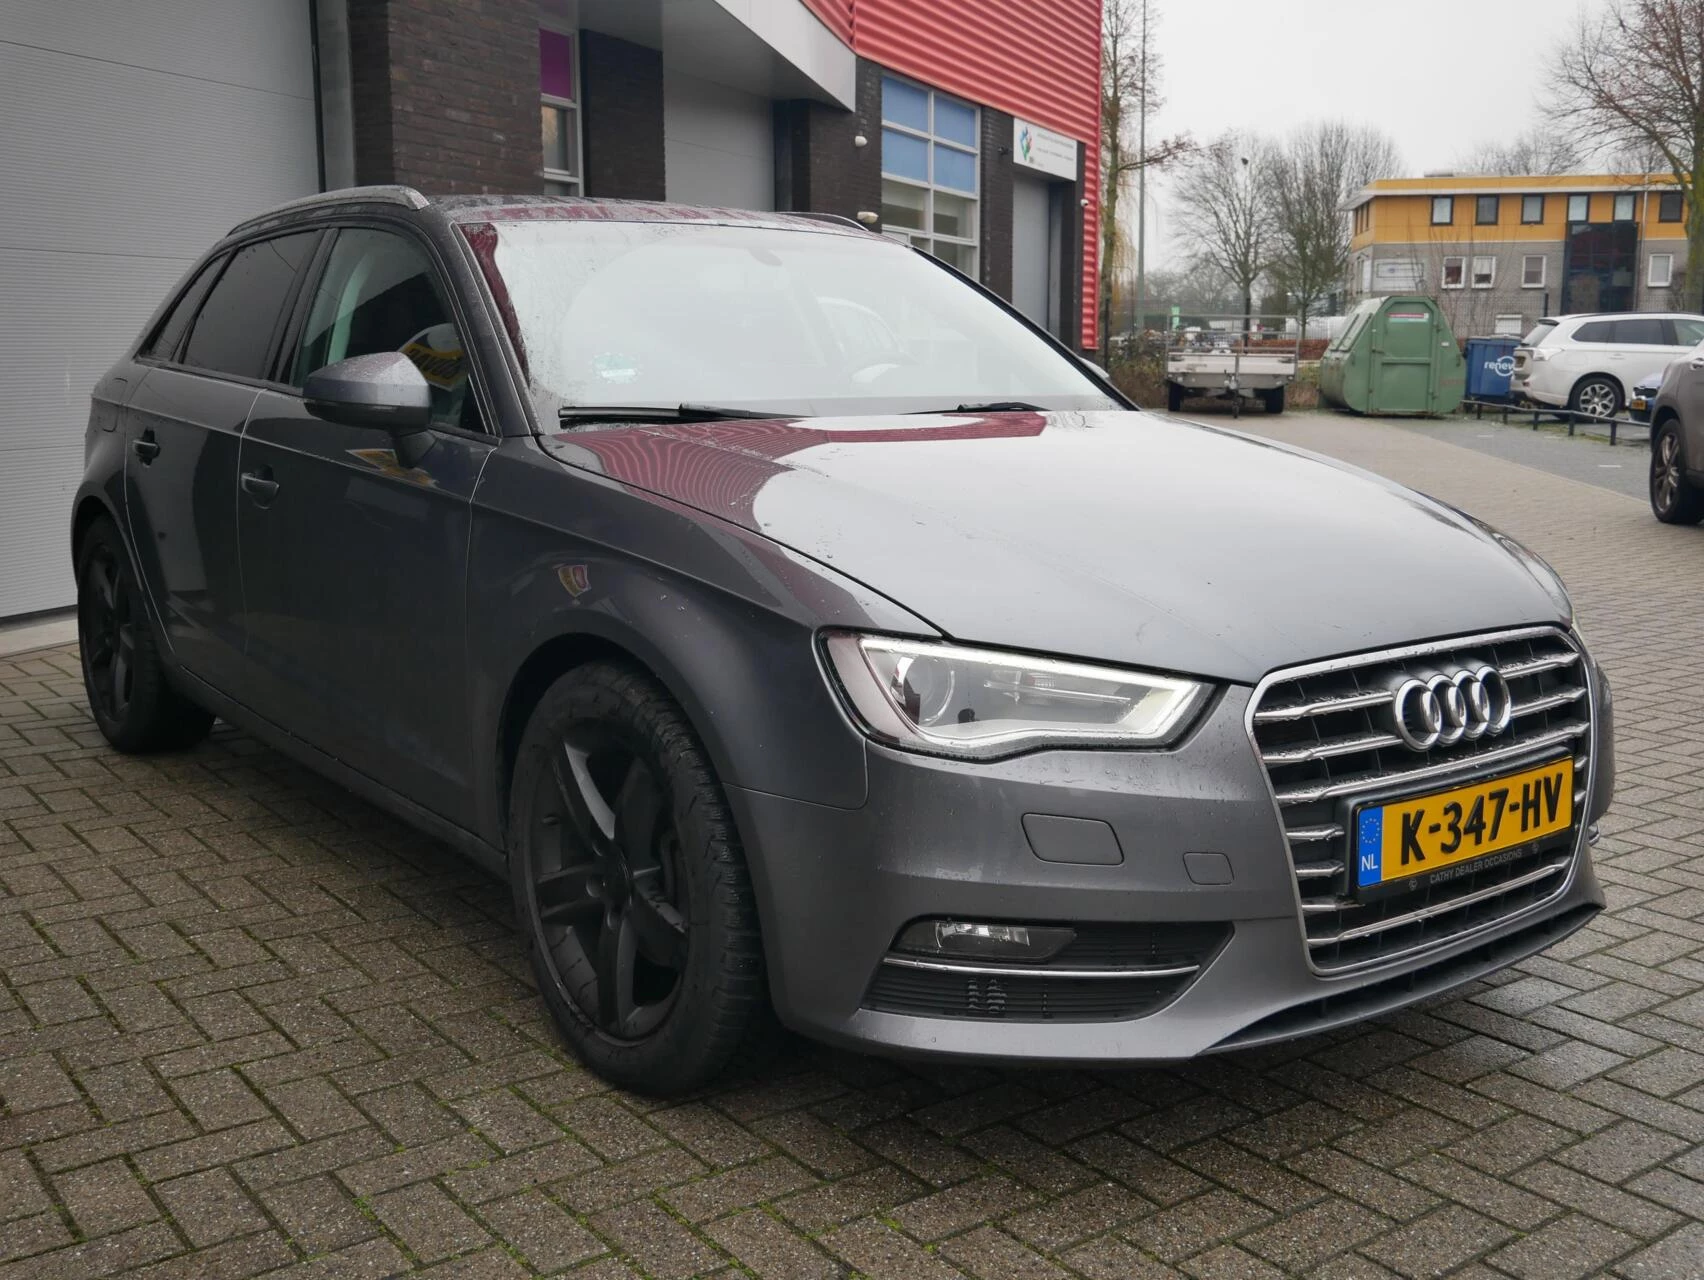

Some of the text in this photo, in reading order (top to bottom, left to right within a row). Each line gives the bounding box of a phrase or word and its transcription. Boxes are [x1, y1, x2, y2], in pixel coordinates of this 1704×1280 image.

[1401, 773, 1563, 865] K-347-HV
[1361, 853, 1379, 871] NL
[1430, 848, 1523, 884] CATHY DEALER OCCASIONS
